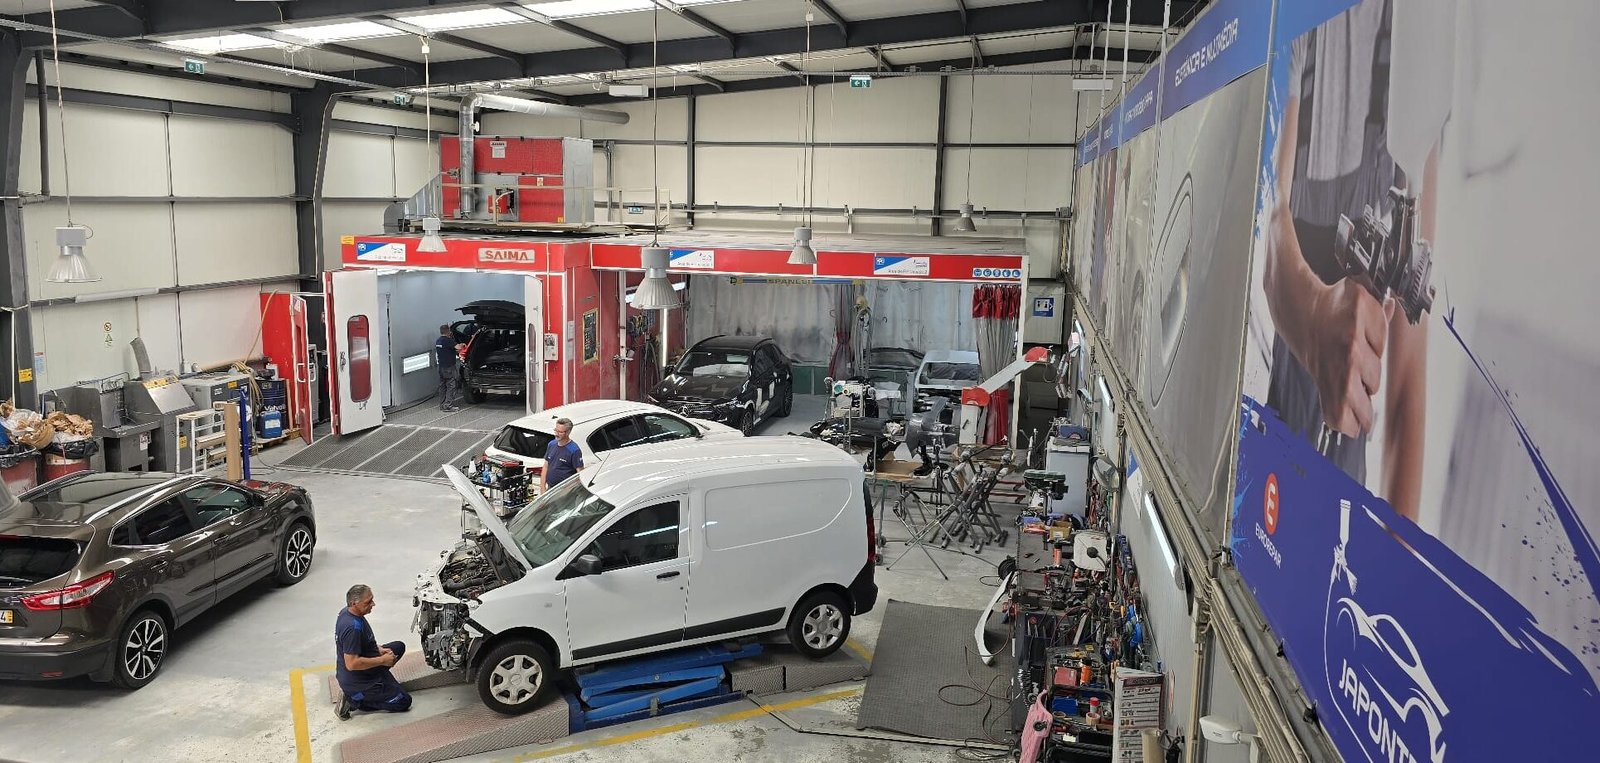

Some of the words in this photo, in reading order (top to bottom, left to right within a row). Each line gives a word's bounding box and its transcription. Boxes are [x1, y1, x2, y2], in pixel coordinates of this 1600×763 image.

[485, 250, 528, 261] SAIMA
[1255, 522, 1282, 569] EUROREPAR
[1338, 658, 1418, 763] JAPONT
